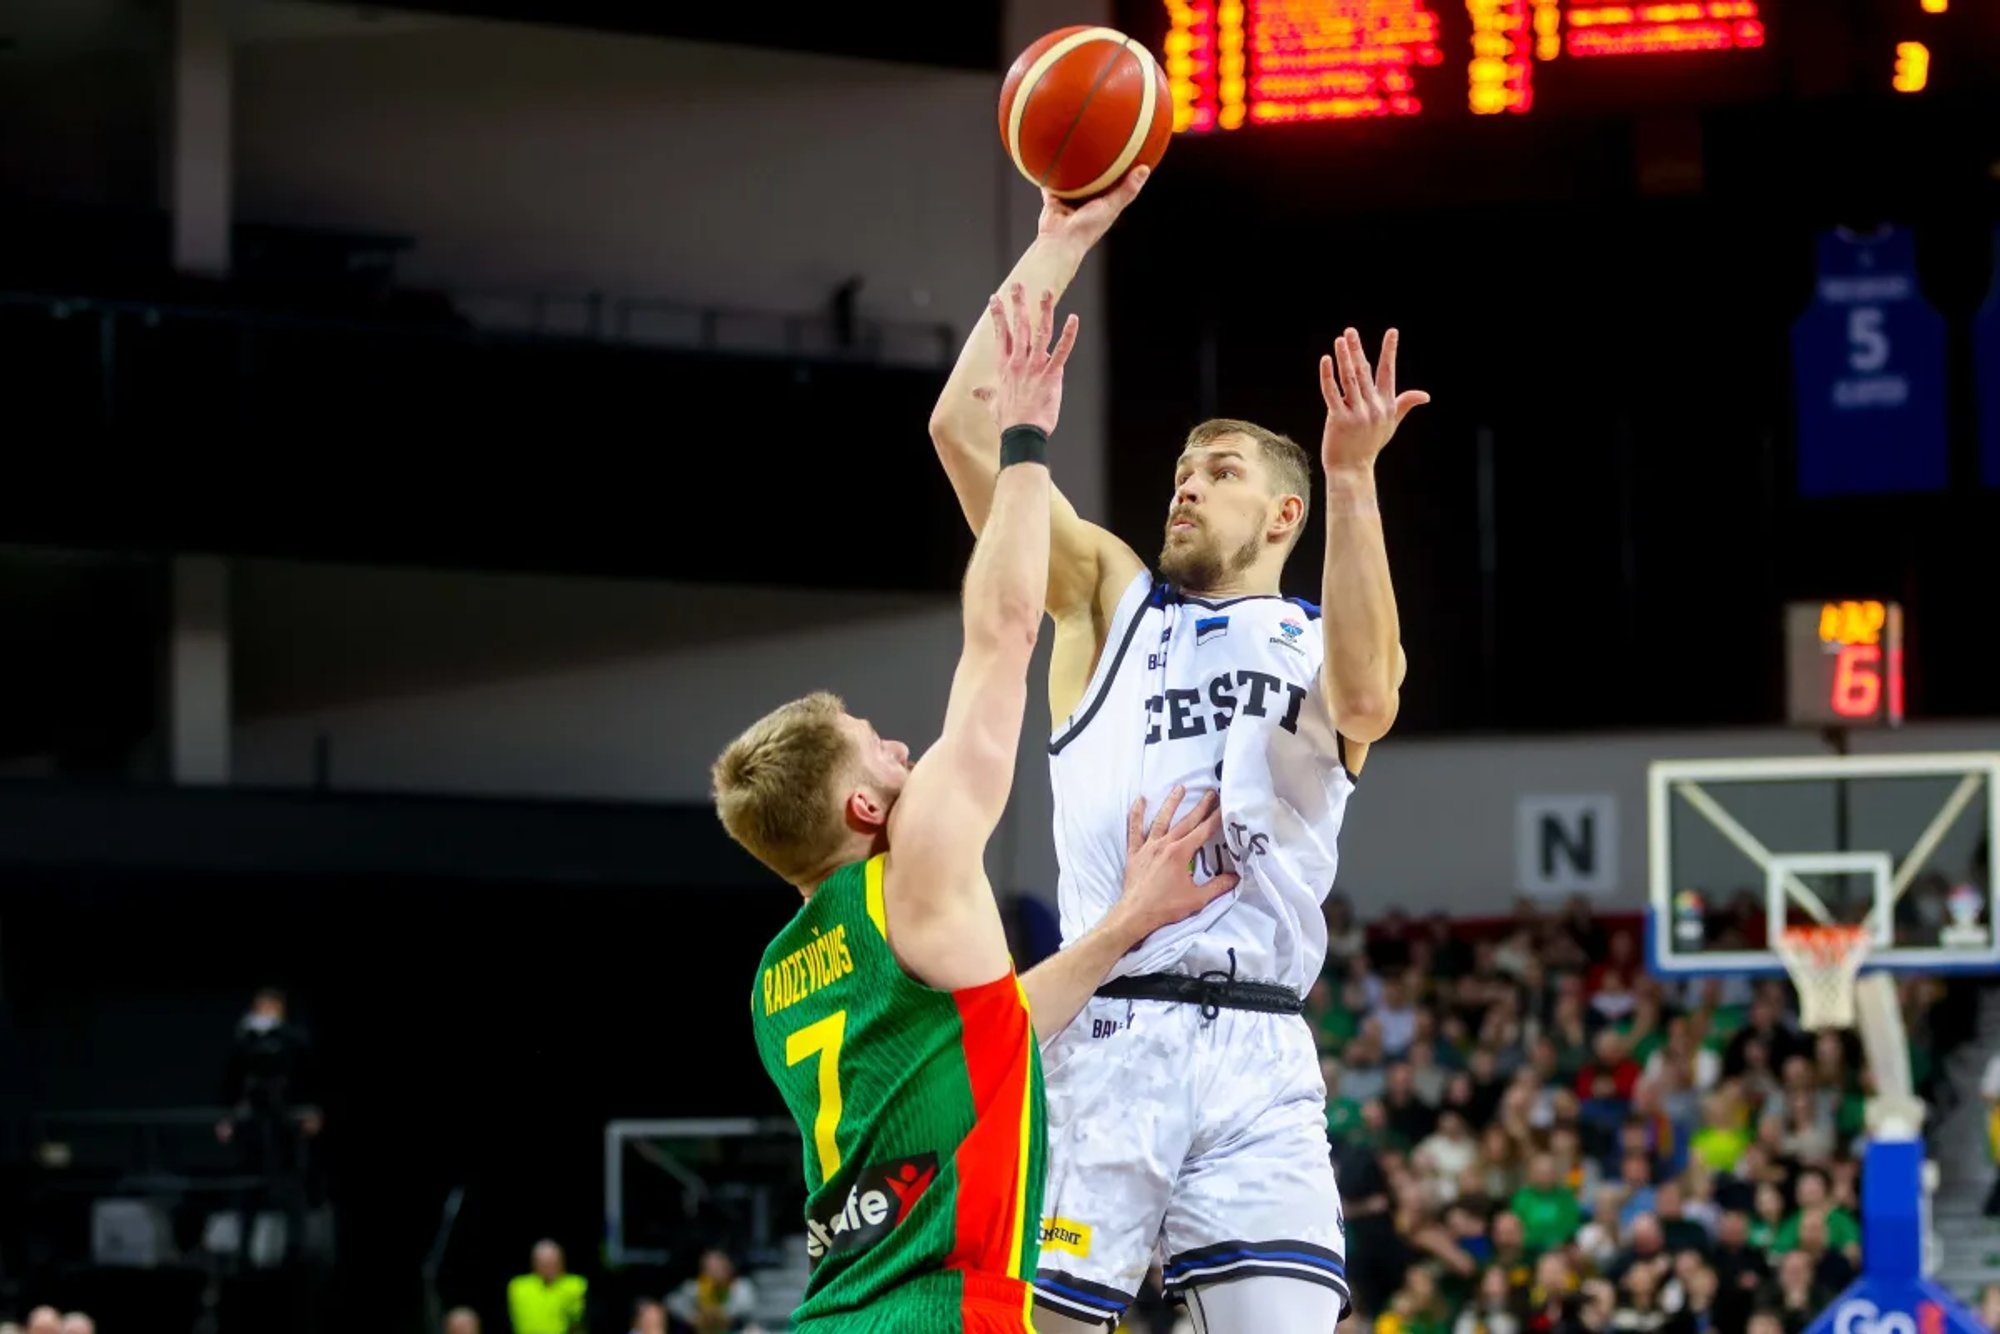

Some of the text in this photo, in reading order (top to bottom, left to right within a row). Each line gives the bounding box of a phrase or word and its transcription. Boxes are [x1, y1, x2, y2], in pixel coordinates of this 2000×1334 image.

[1850, 307, 1890, 371] 5
[1831, 644, 1881, 717] 6
[1539, 810, 1595, 877] N
[763, 923, 854, 1016] RADZEVIČIUS
[785, 1010, 847, 1184] 7
